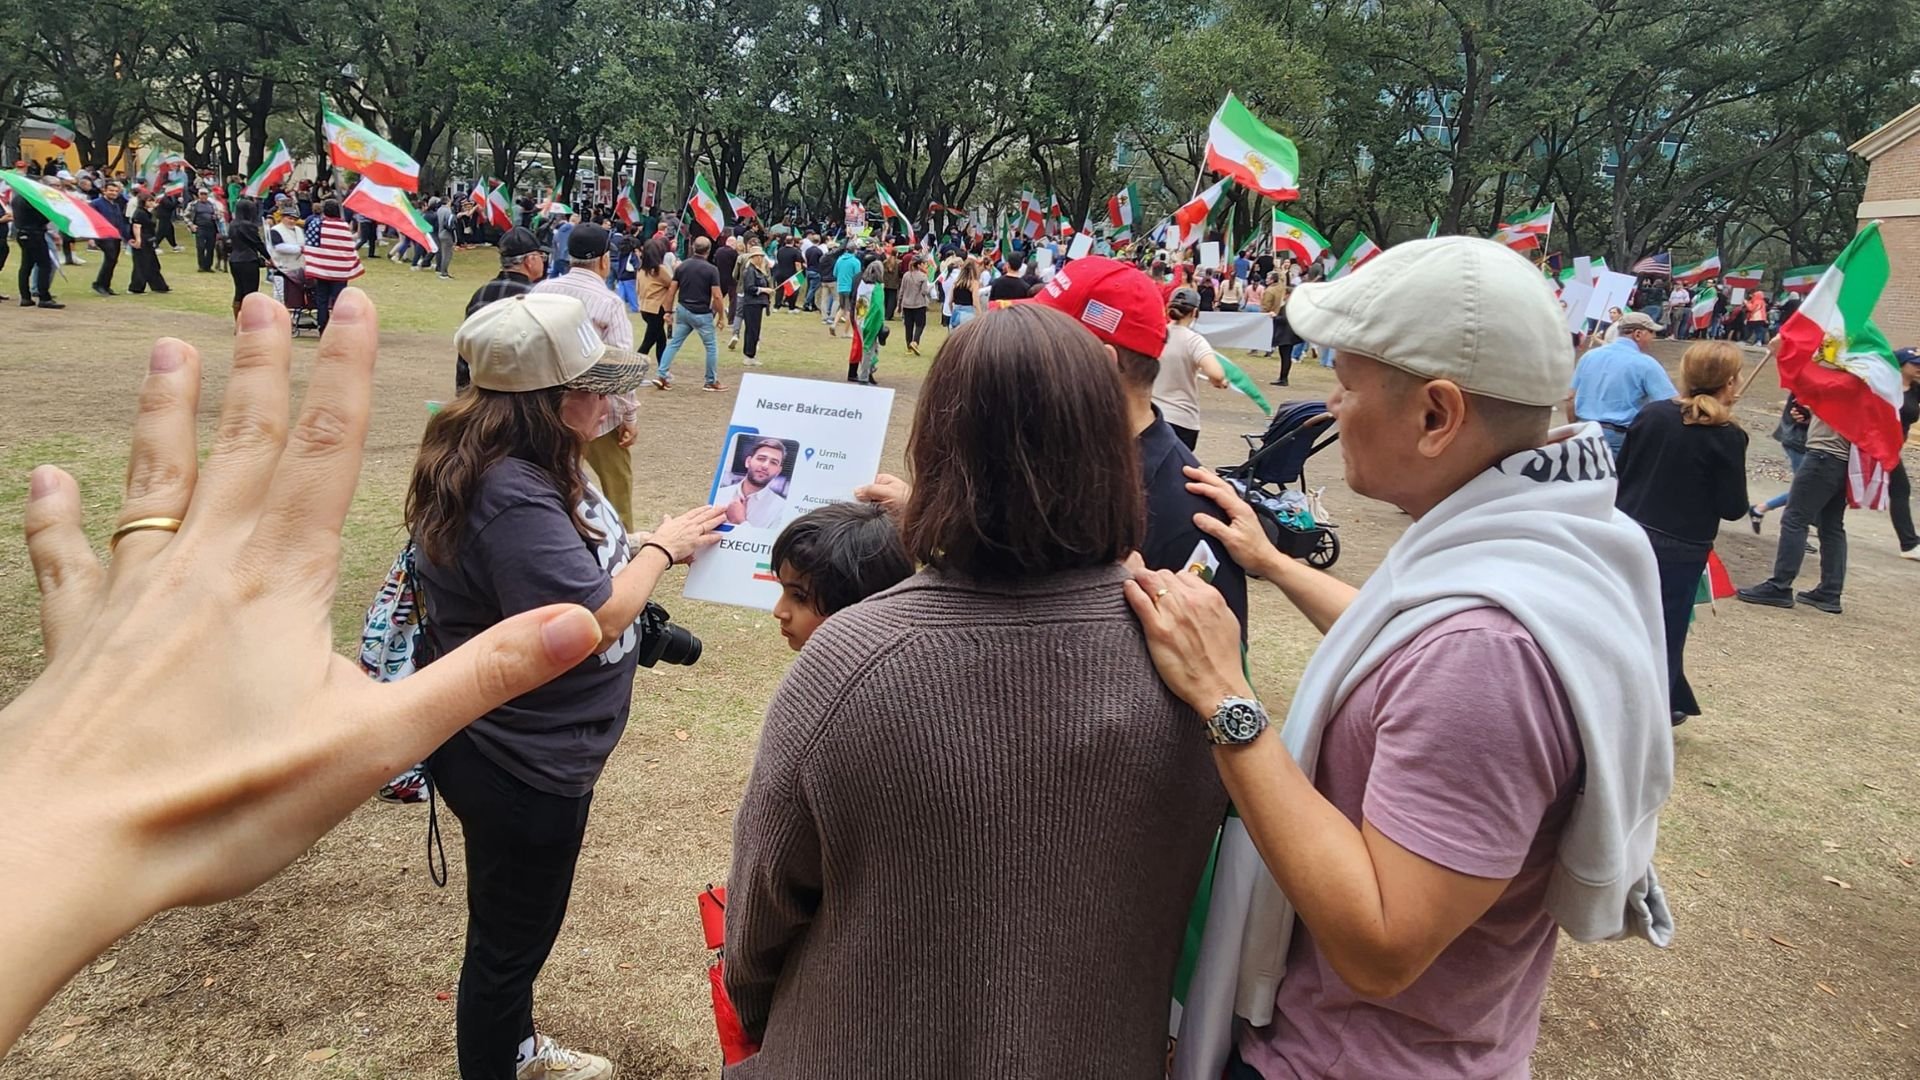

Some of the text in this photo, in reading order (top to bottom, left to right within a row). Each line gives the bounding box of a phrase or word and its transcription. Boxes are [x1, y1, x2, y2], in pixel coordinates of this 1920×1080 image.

[756, 398, 863, 420] Naser Bakrzadeh
[819, 449, 847, 459] Urmia
[815, 461, 835, 471] Iran
[719, 539, 771, 555] EXECUTI
